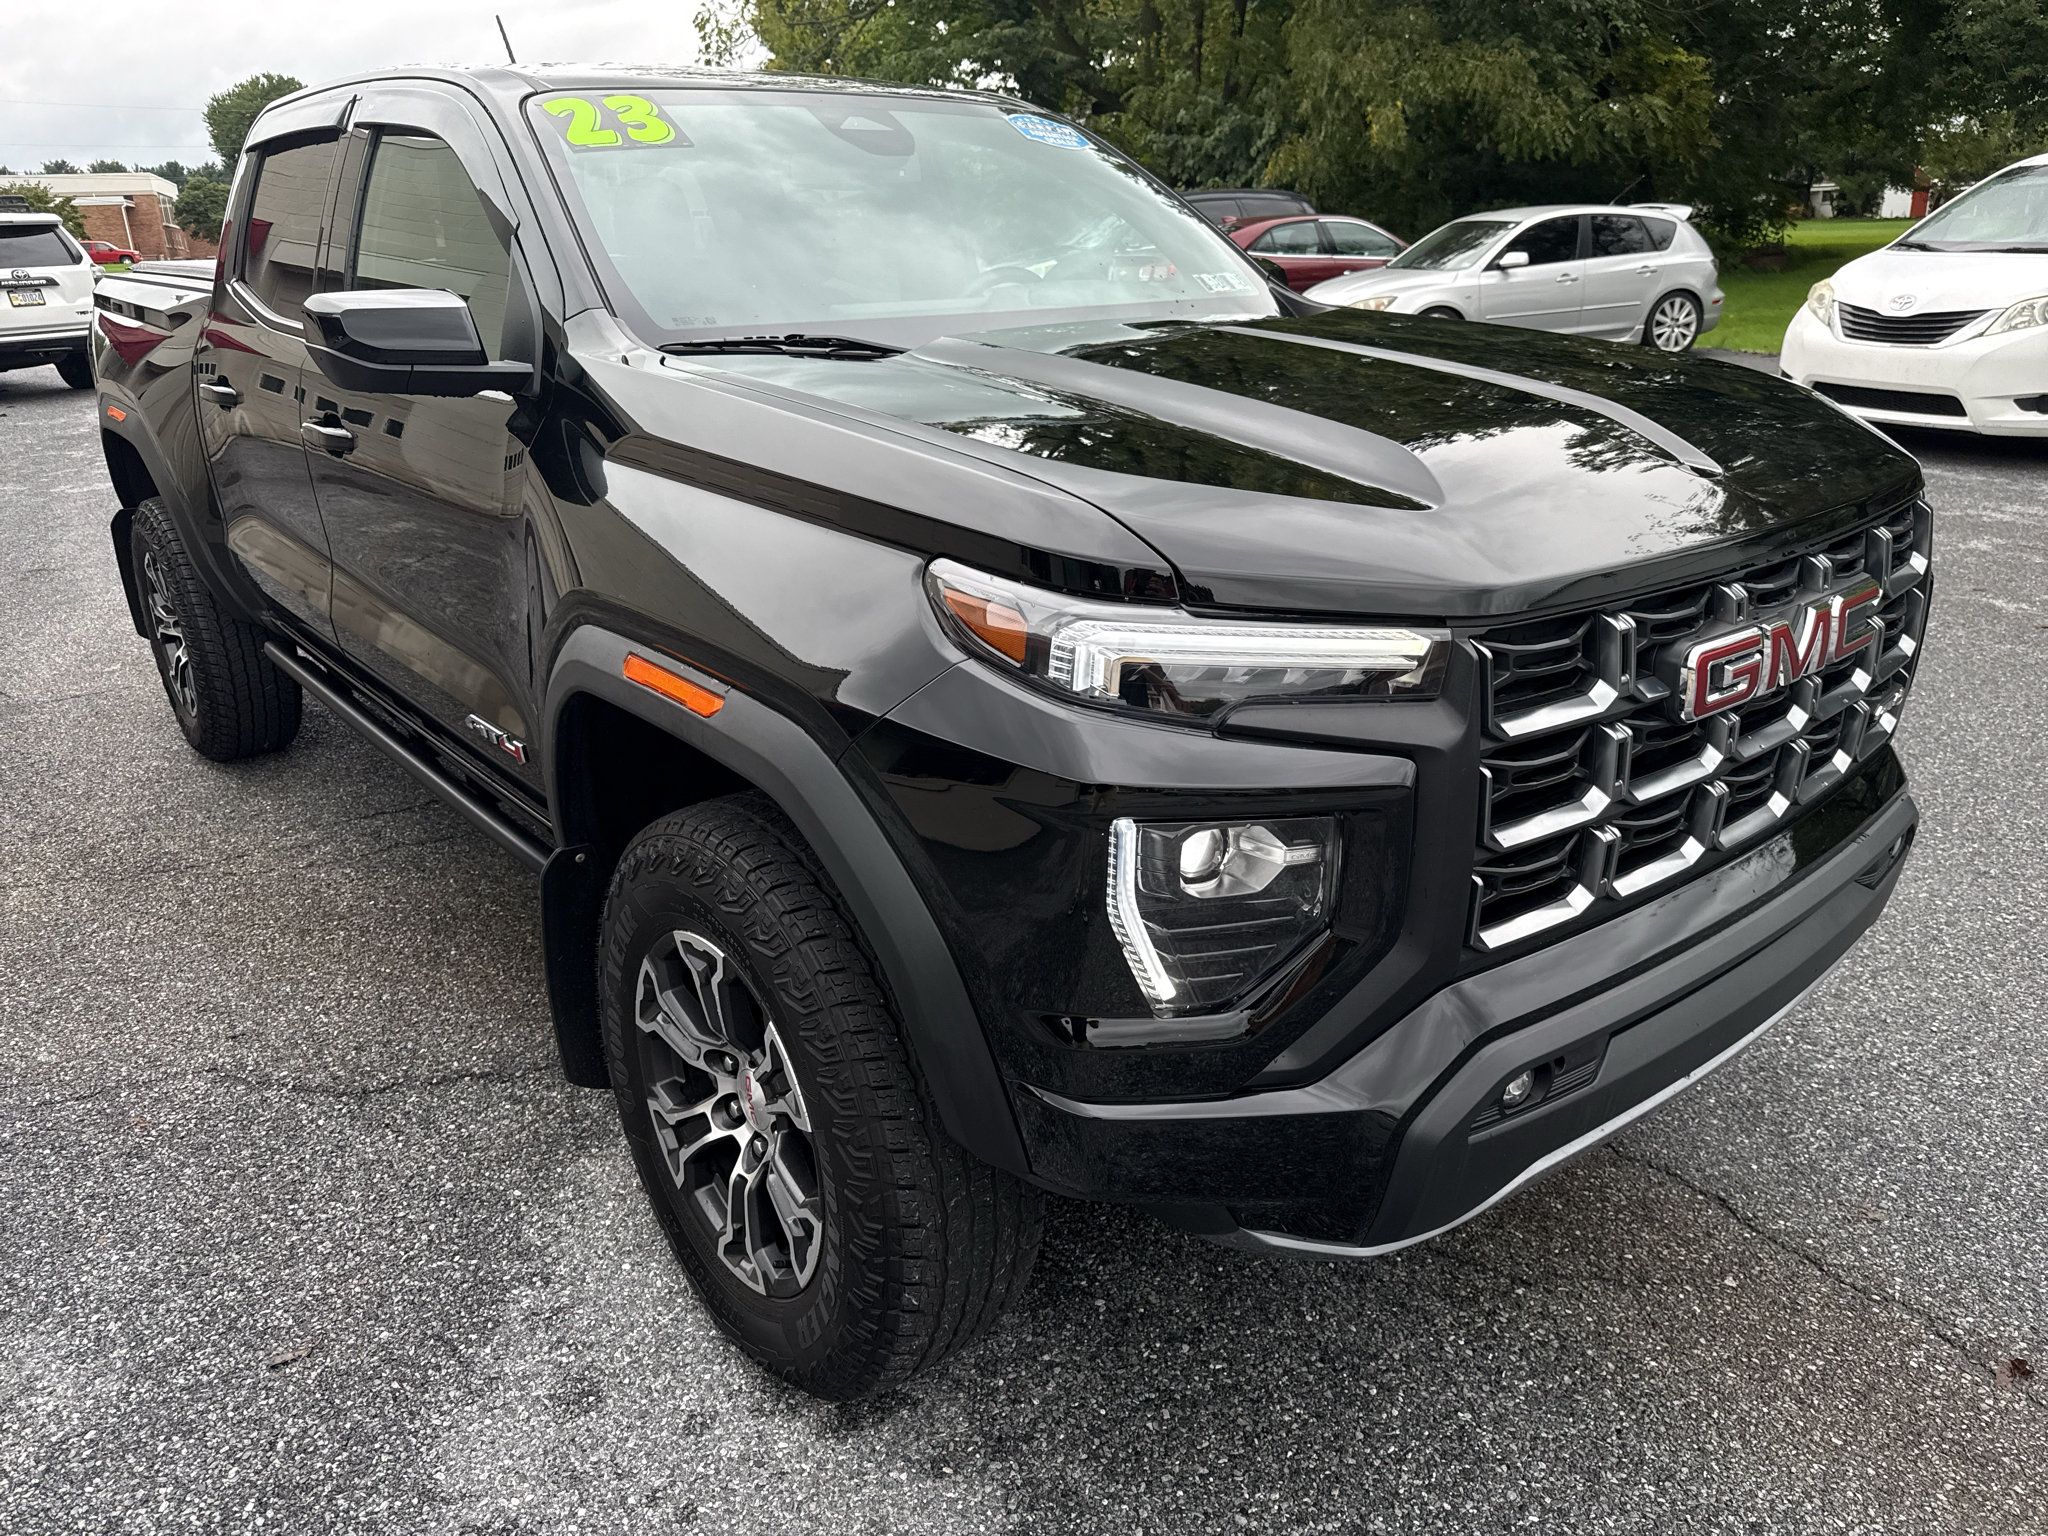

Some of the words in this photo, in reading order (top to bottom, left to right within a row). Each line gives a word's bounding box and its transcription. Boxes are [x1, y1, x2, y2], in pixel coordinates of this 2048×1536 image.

[543, 95, 675, 147] 23
[1679, 584, 1883, 723] GMC
[465, 713, 526, 765] AT4
[744, 1073, 760, 1129] GMC
